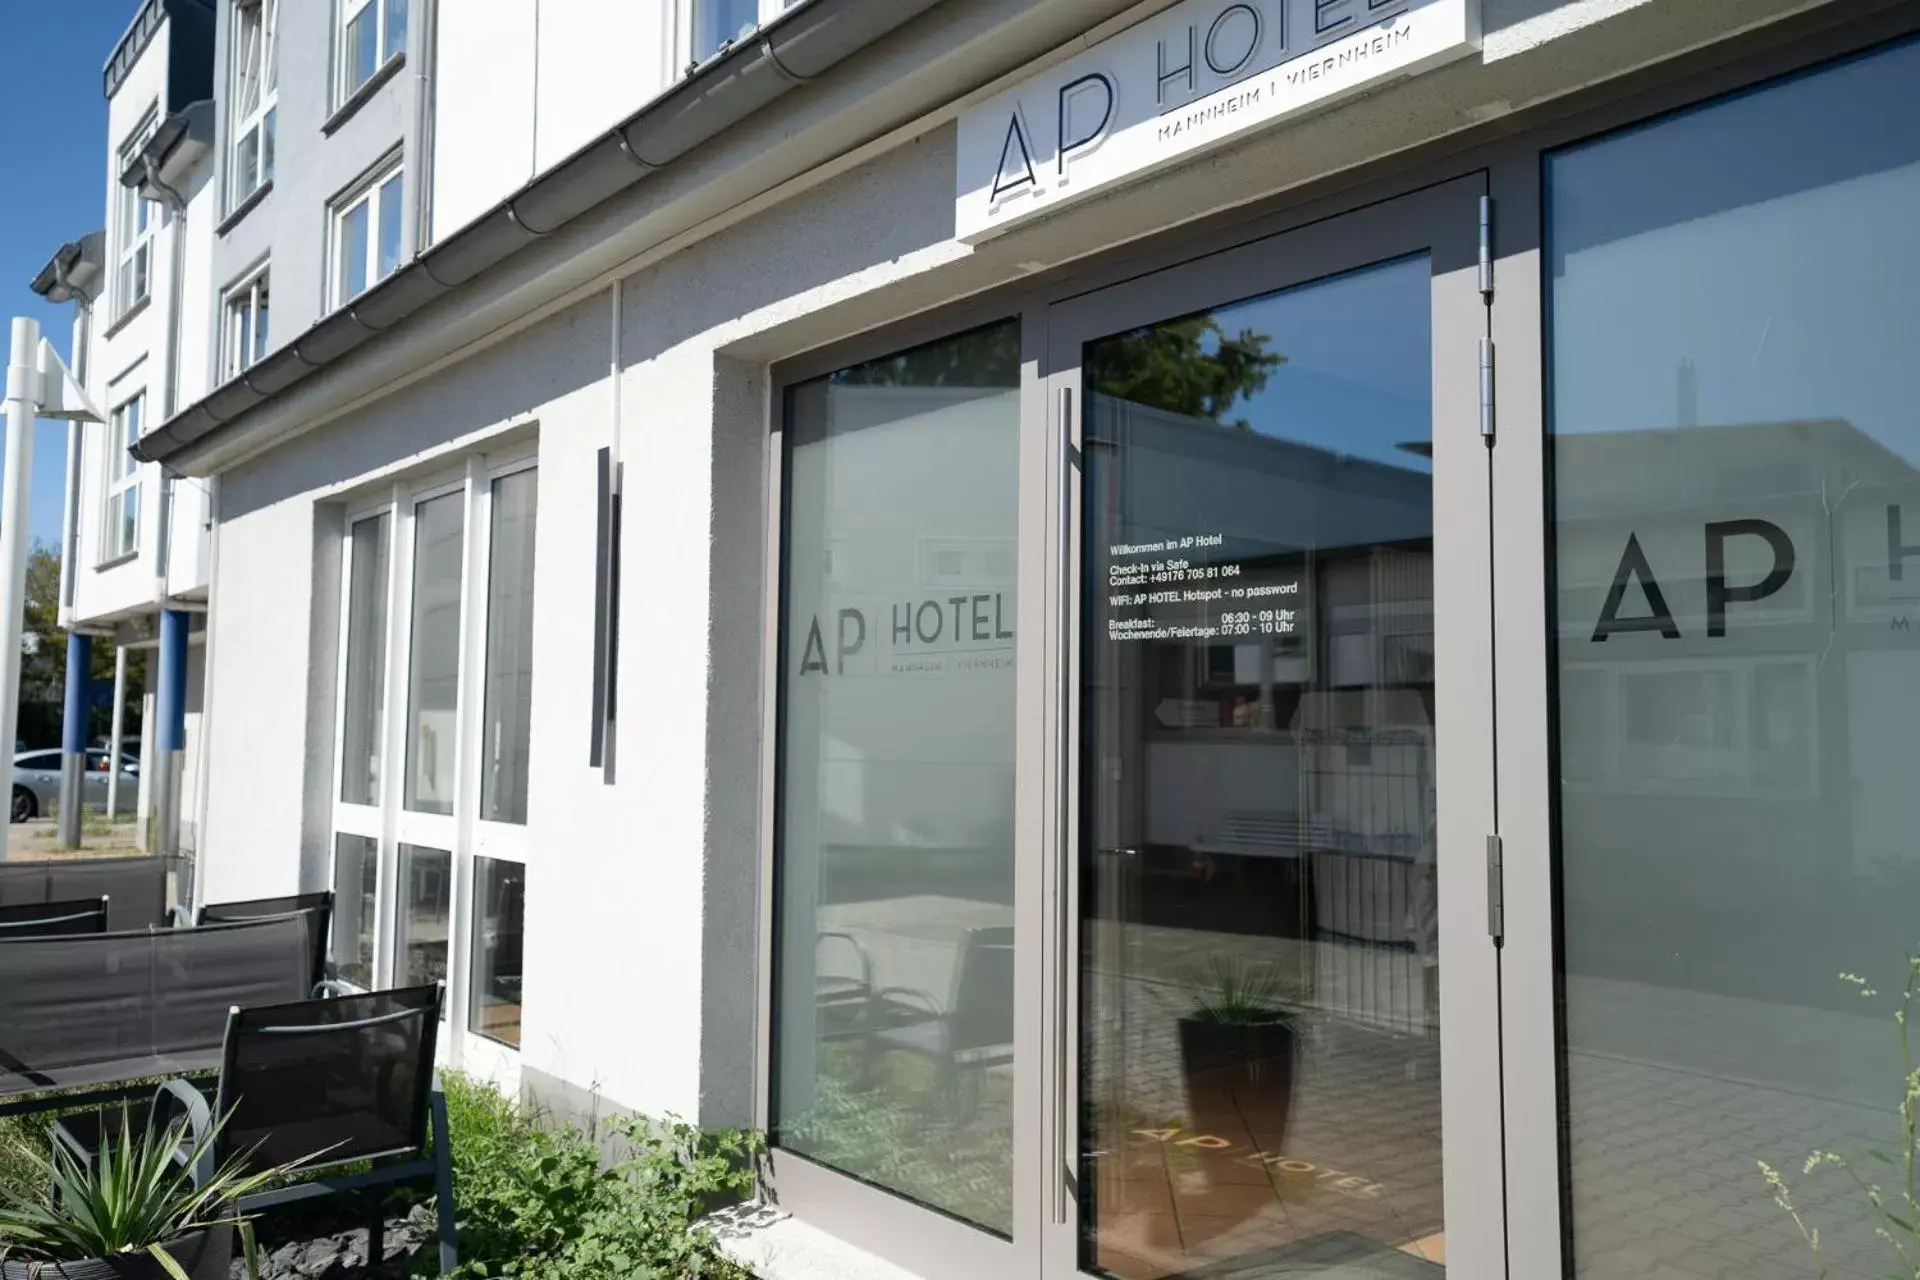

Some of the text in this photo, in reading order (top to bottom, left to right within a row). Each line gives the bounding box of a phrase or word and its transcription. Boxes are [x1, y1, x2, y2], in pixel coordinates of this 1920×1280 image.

[1158, 88, 1261, 142] MANNHEIM
[1287, 25, 1411, 86] VIERNHEIM
[990, 72, 1113, 203] AP
[1110, 533, 1222, 556] Willkommen im AP Hotel
[1109, 559, 1189, 576] Check-In via Safe
[1109, 565, 1240, 587] Contact: +49176 705 81 064
[1590, 518, 1796, 643] AP
[1133, 594, 1147, 605] AP
[1149, 591, 1182, 604] HOTEL
[1183, 589, 1222, 602] Hotspot
[1231, 588, 1244, 598] no
[1246, 581, 1298, 599] password
[1221, 611, 1250, 624] 06:30
[1259, 610, 1273, 622] 09
[1275, 609, 1295, 621] Uhr
[799, 592, 1014, 676] AP HOTEL
[1109, 626, 1220, 640] Wochenende/Feiertage:
[1221, 623, 1250, 635] 07:00
[1261, 622, 1273, 633] 10
[1275, 620, 1295, 633] Uhr
